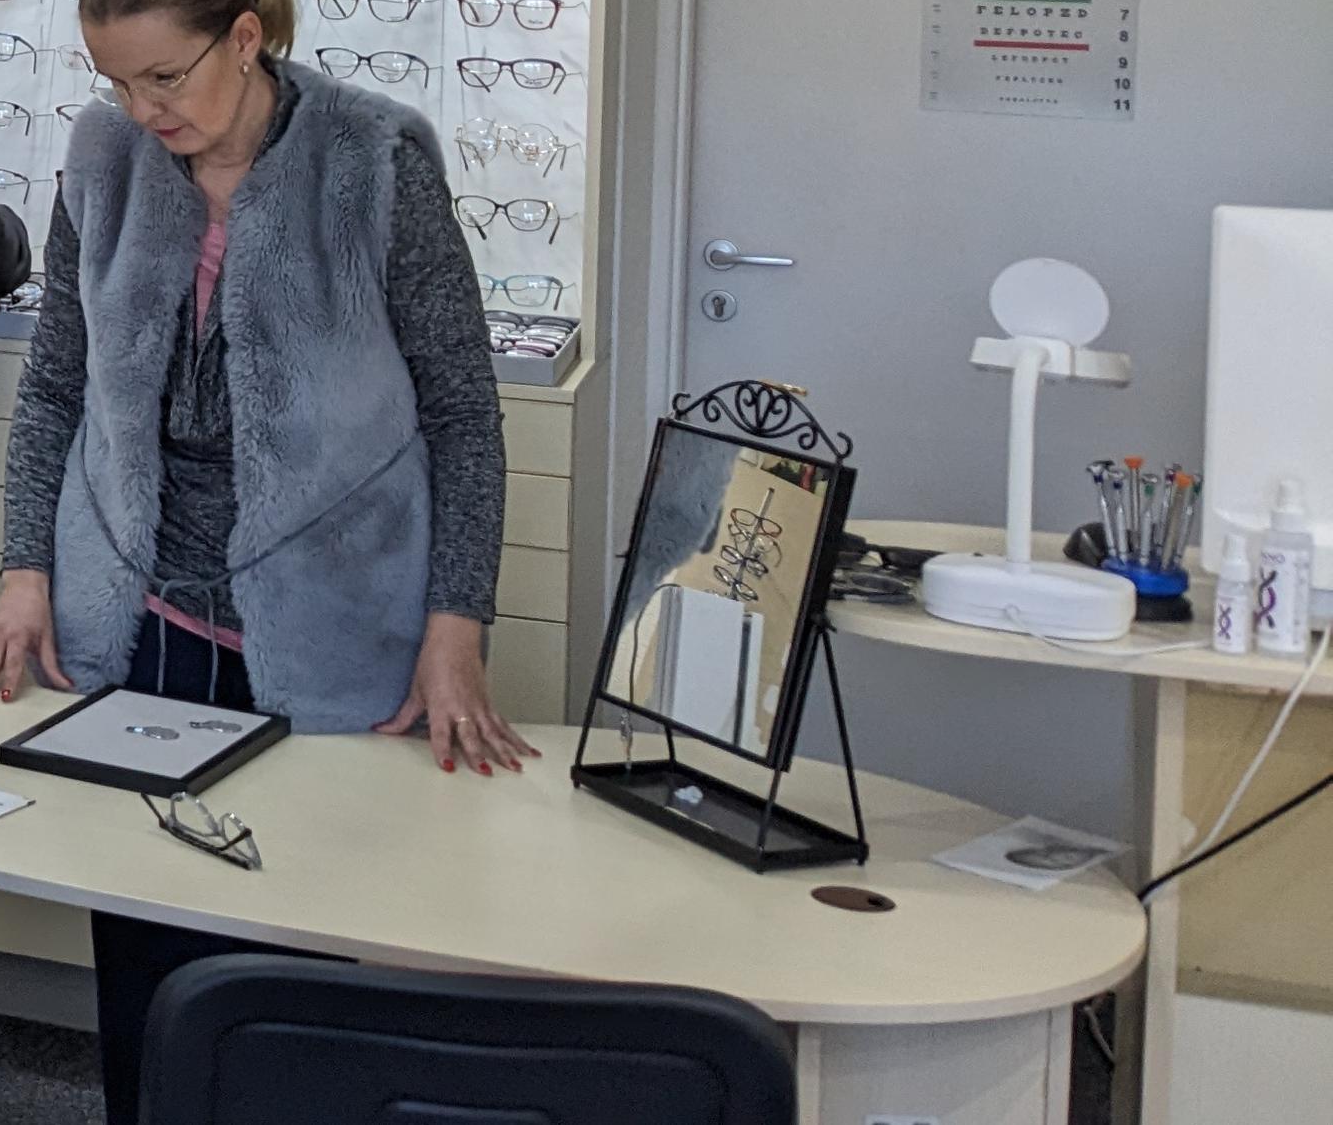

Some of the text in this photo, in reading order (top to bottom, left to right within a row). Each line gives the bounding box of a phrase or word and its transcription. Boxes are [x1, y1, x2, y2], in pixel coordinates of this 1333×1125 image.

[1120, 8, 1129, 20] 7
[1119, 30, 1129, 42] 8
[1118, 57, 1128, 69] 9
[1114, 78, 1131, 90] 10
[1113, 99, 1131, 111] 11
